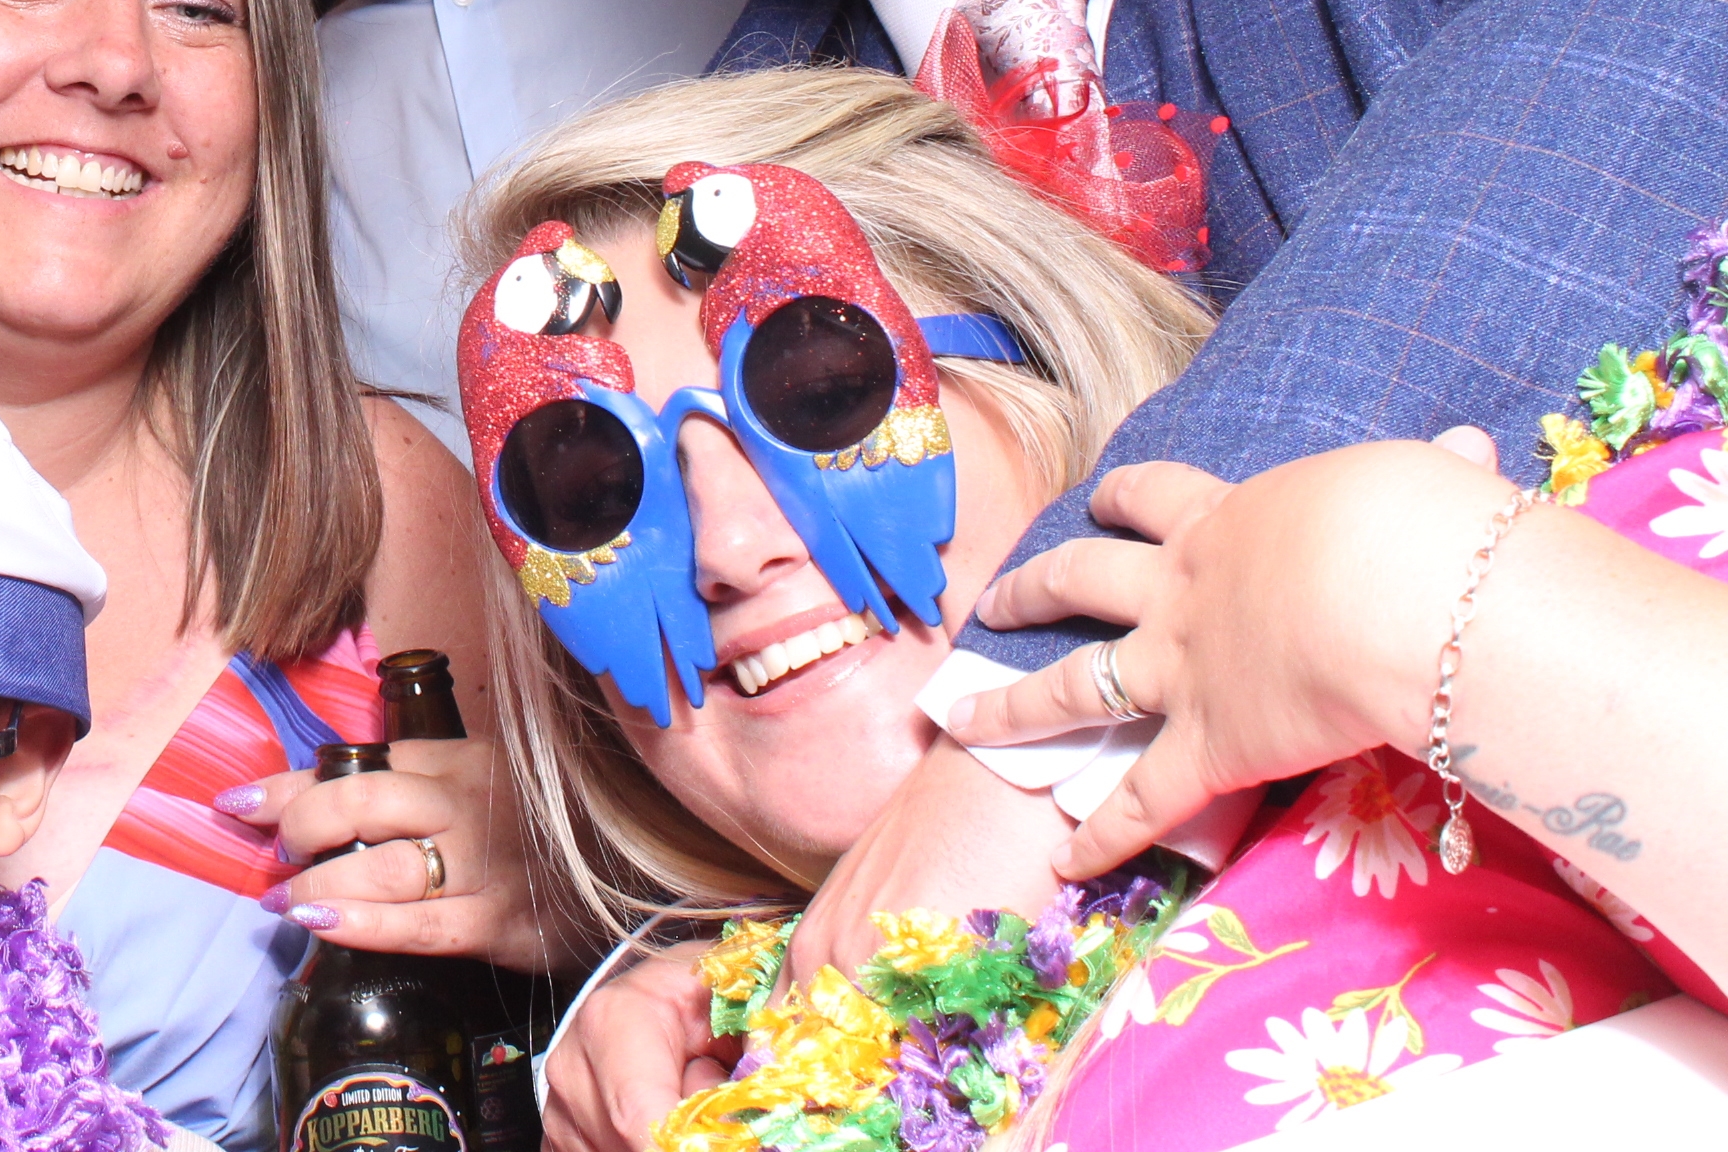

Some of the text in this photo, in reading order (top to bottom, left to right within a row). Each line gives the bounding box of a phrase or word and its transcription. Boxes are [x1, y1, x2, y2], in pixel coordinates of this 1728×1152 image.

[341, 1087, 403, 1107] LIMITED EDITION
[306, 1105, 446, 1152] KOPPARBERG
